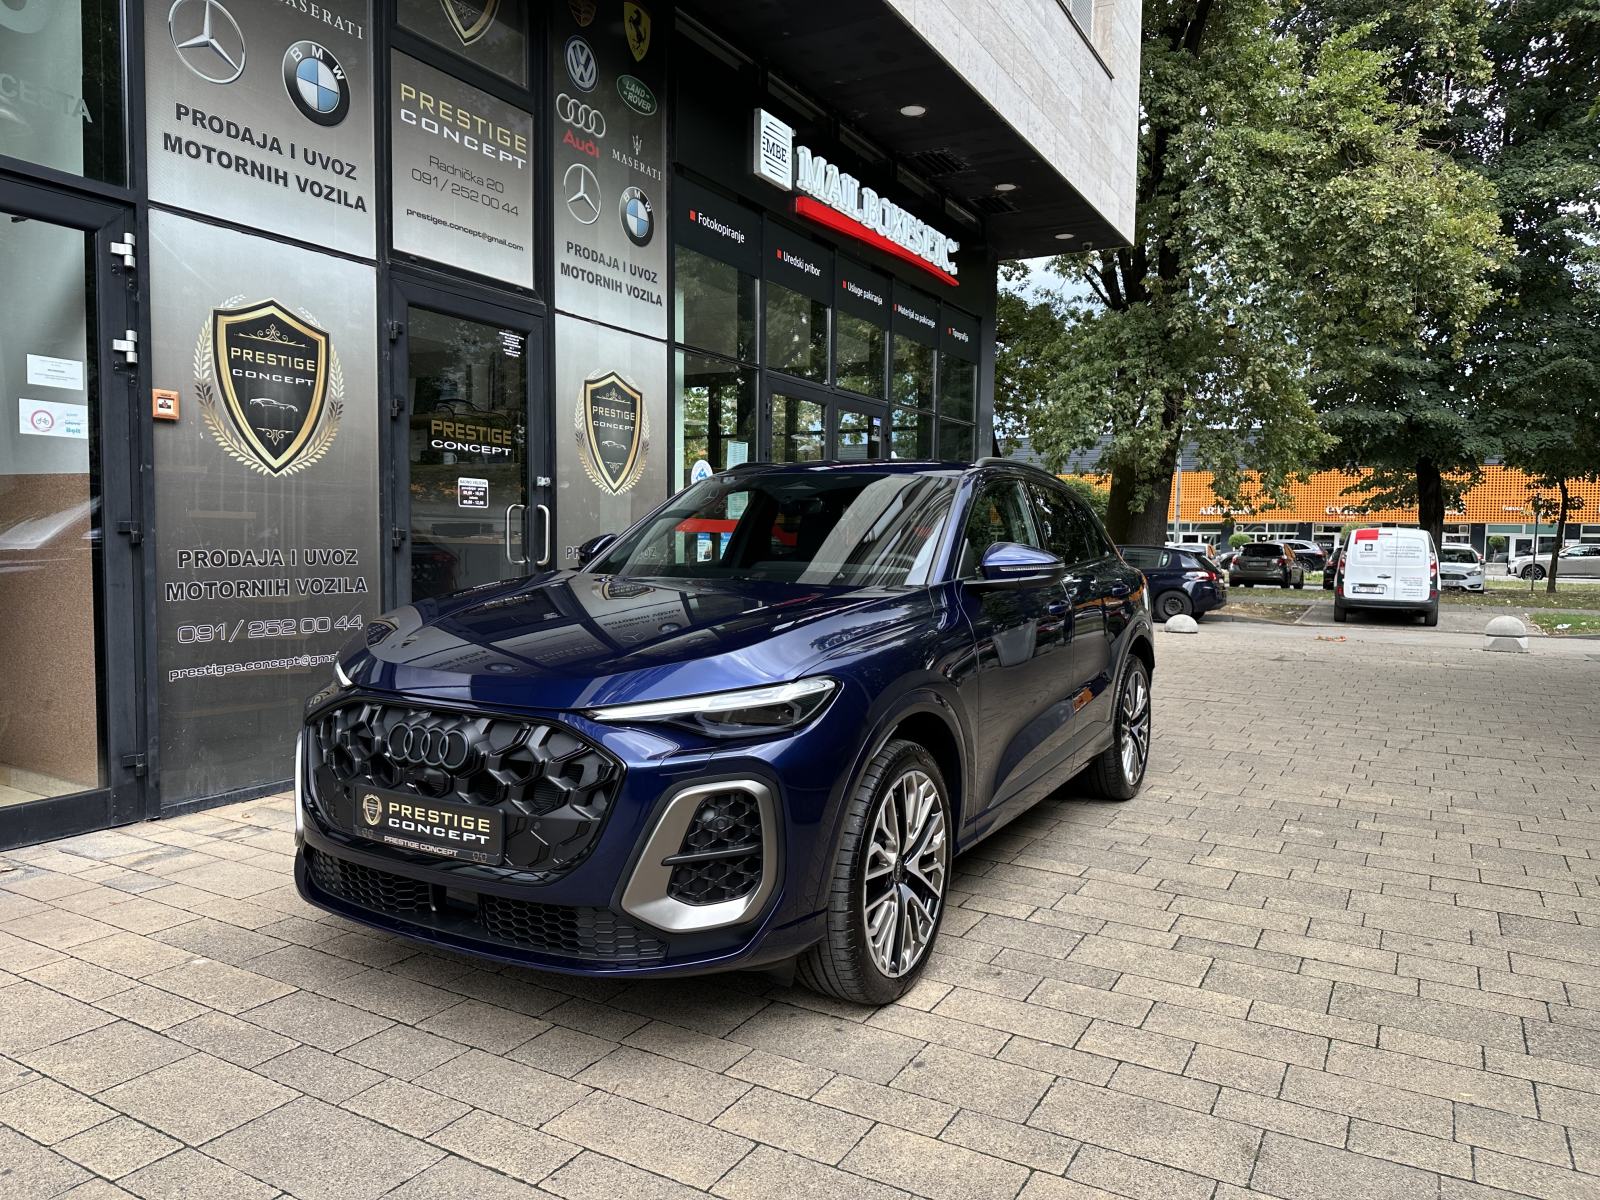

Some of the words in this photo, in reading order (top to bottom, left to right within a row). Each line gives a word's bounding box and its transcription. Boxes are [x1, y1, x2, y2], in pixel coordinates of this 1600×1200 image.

[279, 0, 363, 39] ASERATI
[625, 80, 646, 98] LAND
[627, 93, 652, 112] ROVER
[400, 83, 527, 154] PRESTIGE
[175, 102, 284, 156] PRODAJA
[290, 143, 296, 159] I
[304, 147, 358, 181] UVOZ
[400, 108, 527, 170] CONCEPT
[563, 128, 600, 158] Audi
[765, 138, 787, 164] MBE
[163, 132, 289, 188] MOTORNIH
[295, 174, 367, 213] VOZILA
[429, 155, 484, 186] Radnička
[486, 178, 505, 194] 20
[612, 149, 663, 181] MASERATI
[451, 182, 480, 202] 252
[481, 194, 500, 210] 00
[501, 202, 519, 217] 44
[796, 145, 862, 223] MAIL
[862, 187, 925, 256] BOXES
[406, 208, 524, 251] prestigee.concept@gmail.com
[698, 212, 745, 243] Fotokopiranje
[566, 241, 620, 271] PRODAJA
[623, 261, 627, 273] I
[630, 263, 658, 284] UVOZ
[783, 251, 804, 270] Uredski
[805, 258, 821, 277] pribor
[560, 262, 622, 293] MOTORNIH
[626, 283, 663, 306] VOZILA
[230, 347, 316, 372] PRESTIGE
[232, 368, 315, 387] CONCEPT
[592, 405, 636, 421] PRESTIGE
[593, 420, 635, 432] CONCEPT
[431, 419, 512, 445] PRESTIGE
[431, 439, 512, 456] CONCEPT
[177, 549, 284, 568] PRODAJA
[290, 549, 297, 566] I
[304, 549, 358, 566] UVOZ
[165, 579, 290, 602] MOTORNIH
[295, 577, 368, 596] VOZILA
[247, 619, 297, 639] 252
[300, 617, 331, 634] 00
[333, 614, 364, 631] 44
[168, 651, 339, 682] prestigee.concept@gma
[388, 802, 490, 832] PRESTIGE
[388, 816, 490, 845] CONCEPT
[384, 836, 419, 850] PRESTIGE
[420, 843, 459, 857] CONCEPT
